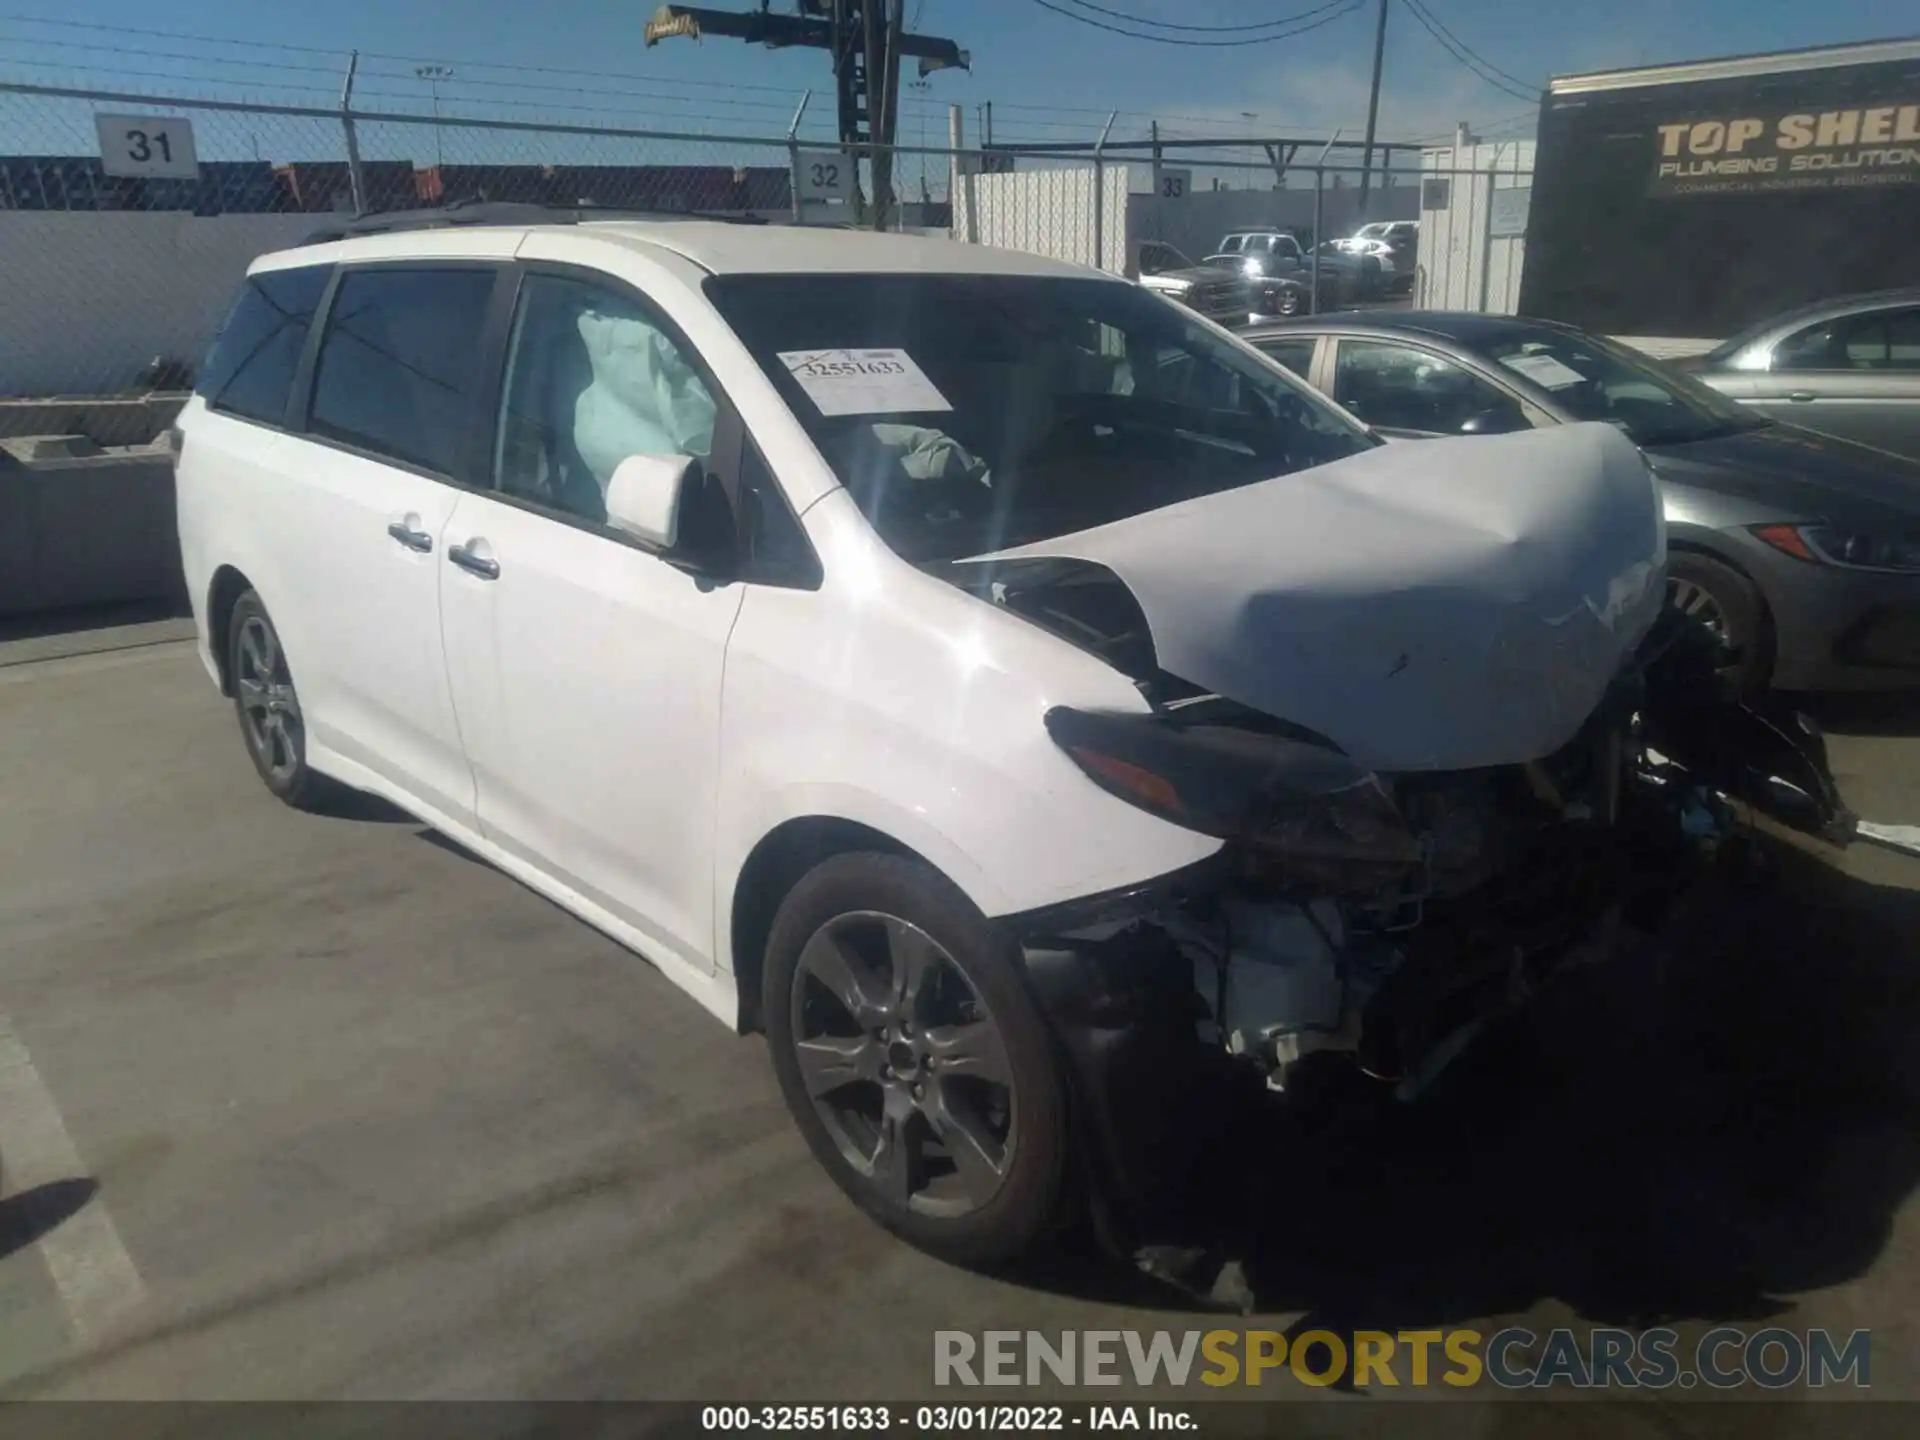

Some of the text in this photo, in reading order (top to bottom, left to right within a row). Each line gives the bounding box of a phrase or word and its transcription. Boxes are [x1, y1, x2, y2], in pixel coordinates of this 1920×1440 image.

[126, 130, 172, 163] 31
[1658, 119, 1764, 157] TOP
[811, 163, 839, 188] 32
[1659, 157, 1777, 178] PLUMBING
[1162, 176, 1182, 198] 33
[805, 360, 905, 377] 32551633
